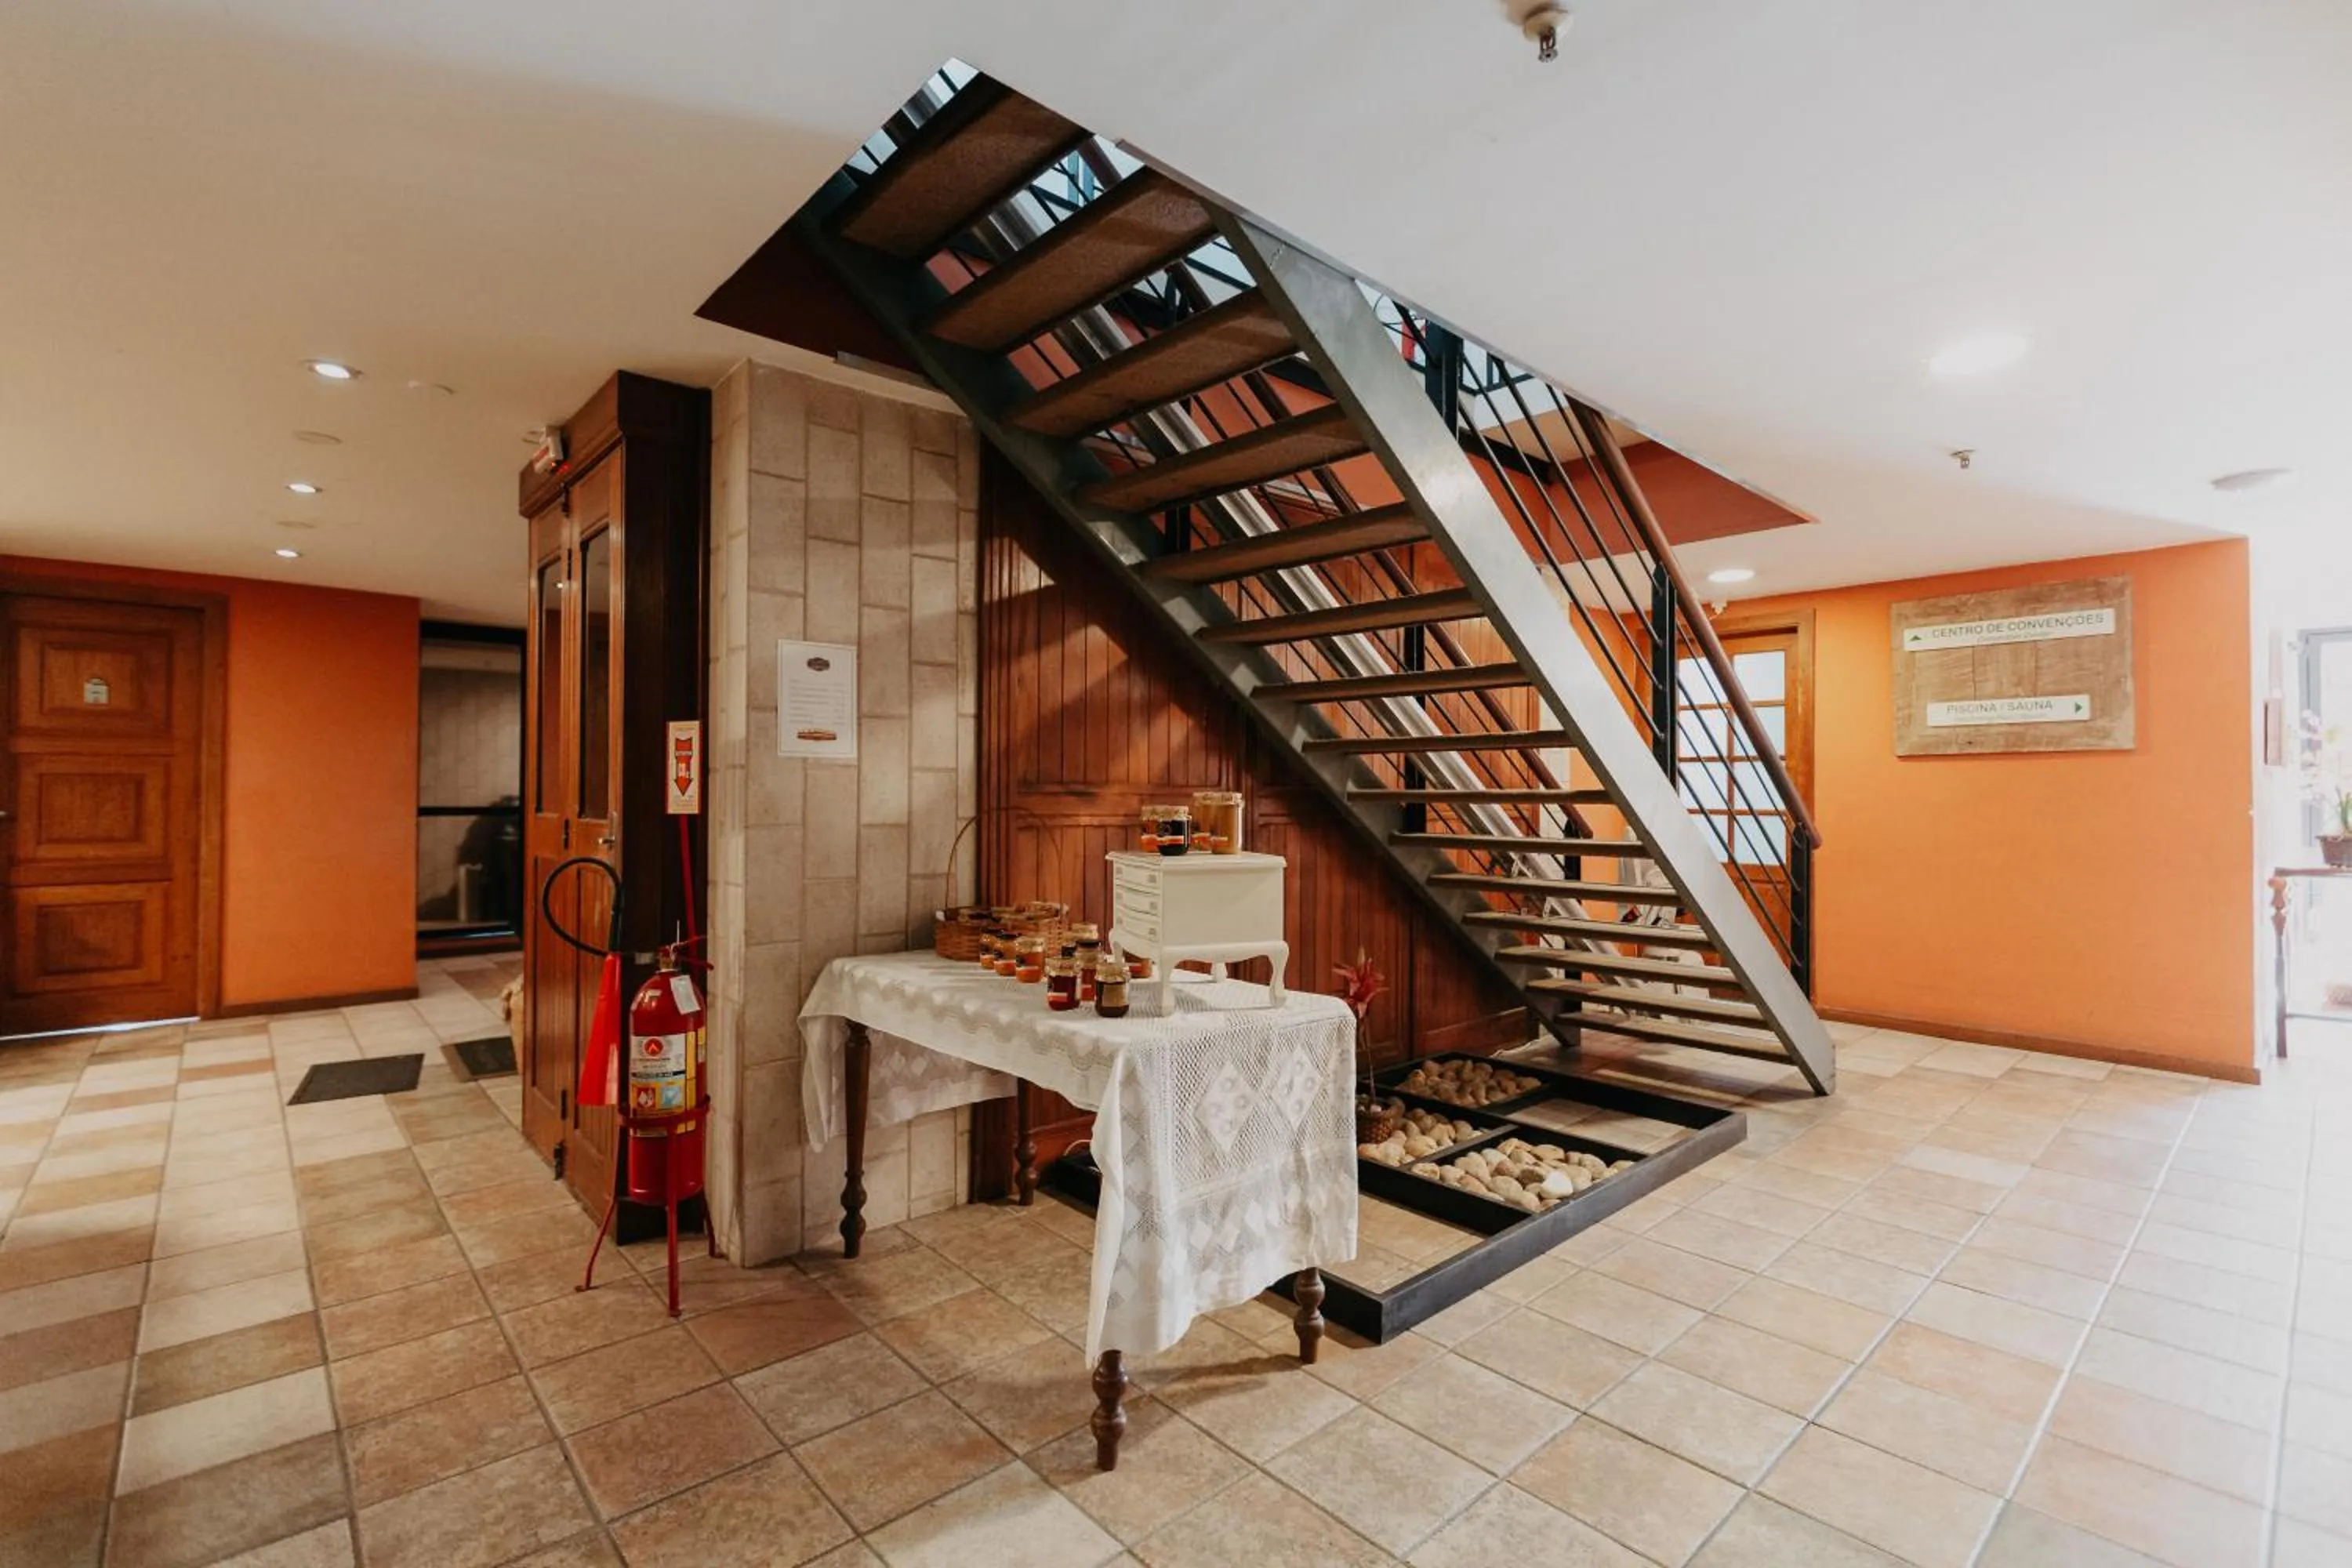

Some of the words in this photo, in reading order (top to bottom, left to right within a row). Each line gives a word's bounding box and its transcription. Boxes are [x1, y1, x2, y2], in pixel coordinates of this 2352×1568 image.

[1932, 624, 1984, 639] CENTRO
[1986, 622, 2005, 634] DE
[1946, 702, 1997, 714] PISCINA
[2006, 699, 2053, 712] SAUNA
